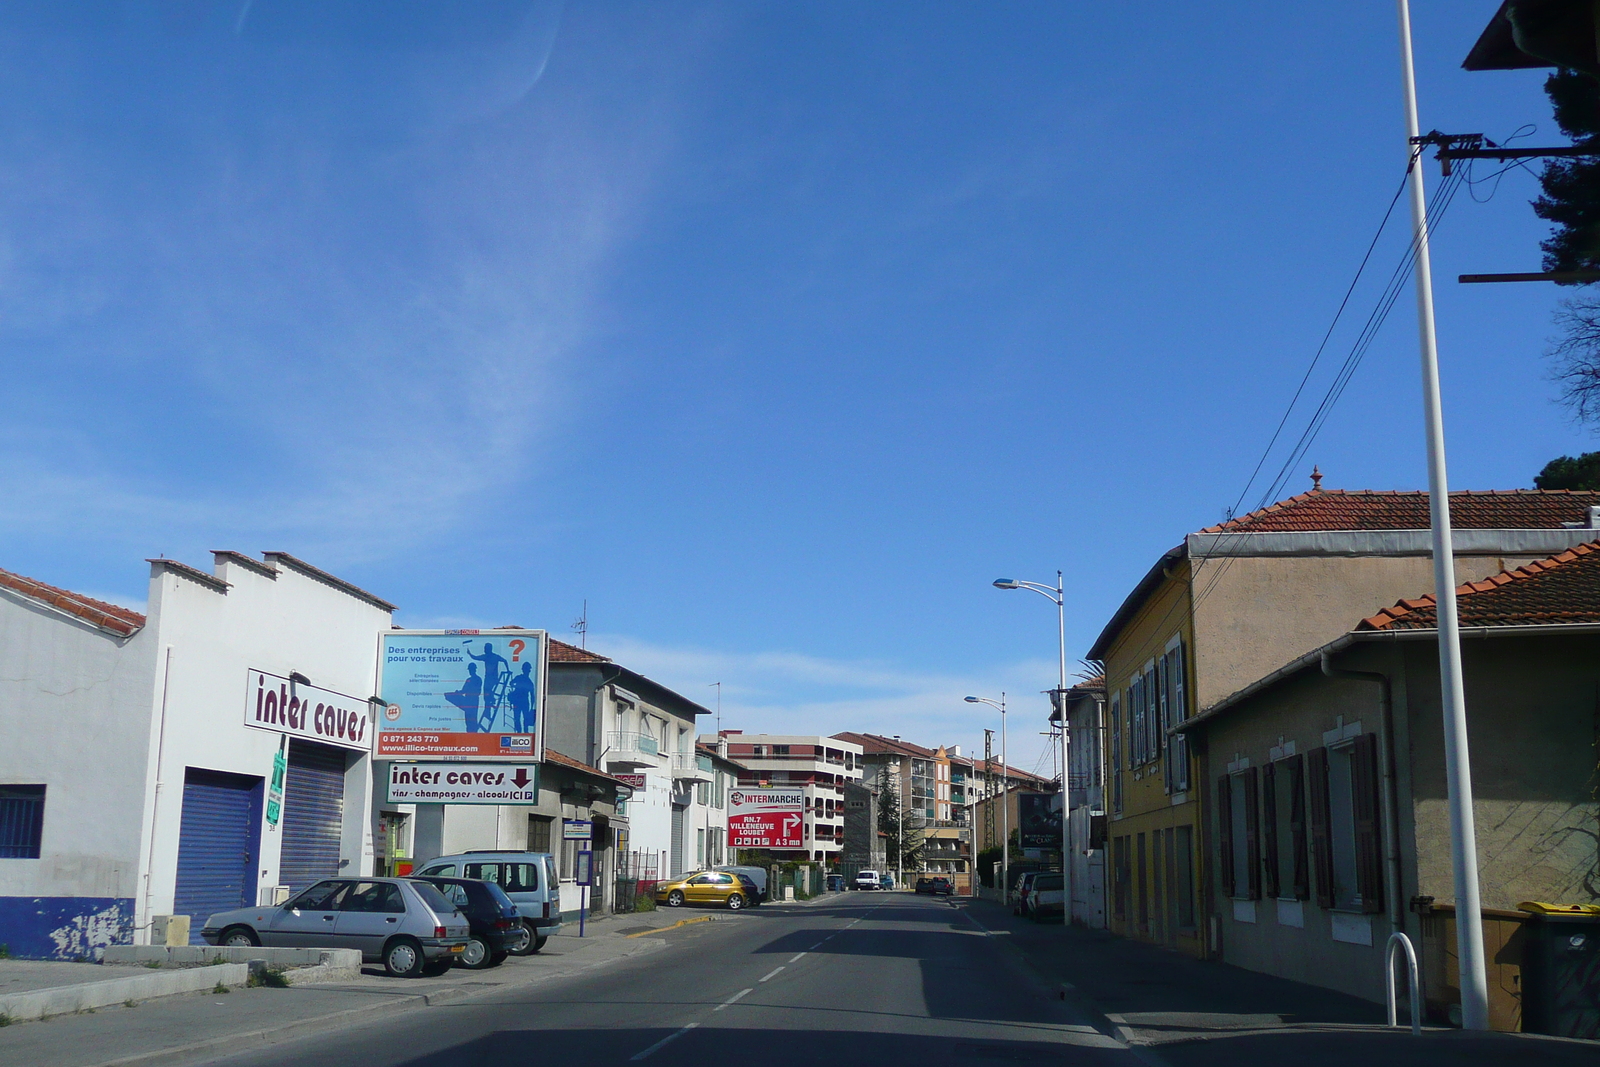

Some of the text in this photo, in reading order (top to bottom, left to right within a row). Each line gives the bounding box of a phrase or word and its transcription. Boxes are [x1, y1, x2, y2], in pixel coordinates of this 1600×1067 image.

[388, 646, 460, 656] Des entreprises
[387, 655, 464, 664] pour vos travaux
[255, 674, 366, 742] inter caves
[382, 735, 439, 743] 0 871 243 770
[382, 744, 478, 752] www.illico-travaux.com
[392, 766, 505, 786] inter caves
[392, 789, 408, 797] vins
[415, 790, 470, 800] champagnes
[477, 790, 509, 798] alcools
[510, 791, 523, 800] ICI
[745, 795, 801, 804] INTERMARCHE
[775, 838, 781, 846] A
[782, 838, 787, 846] 3
